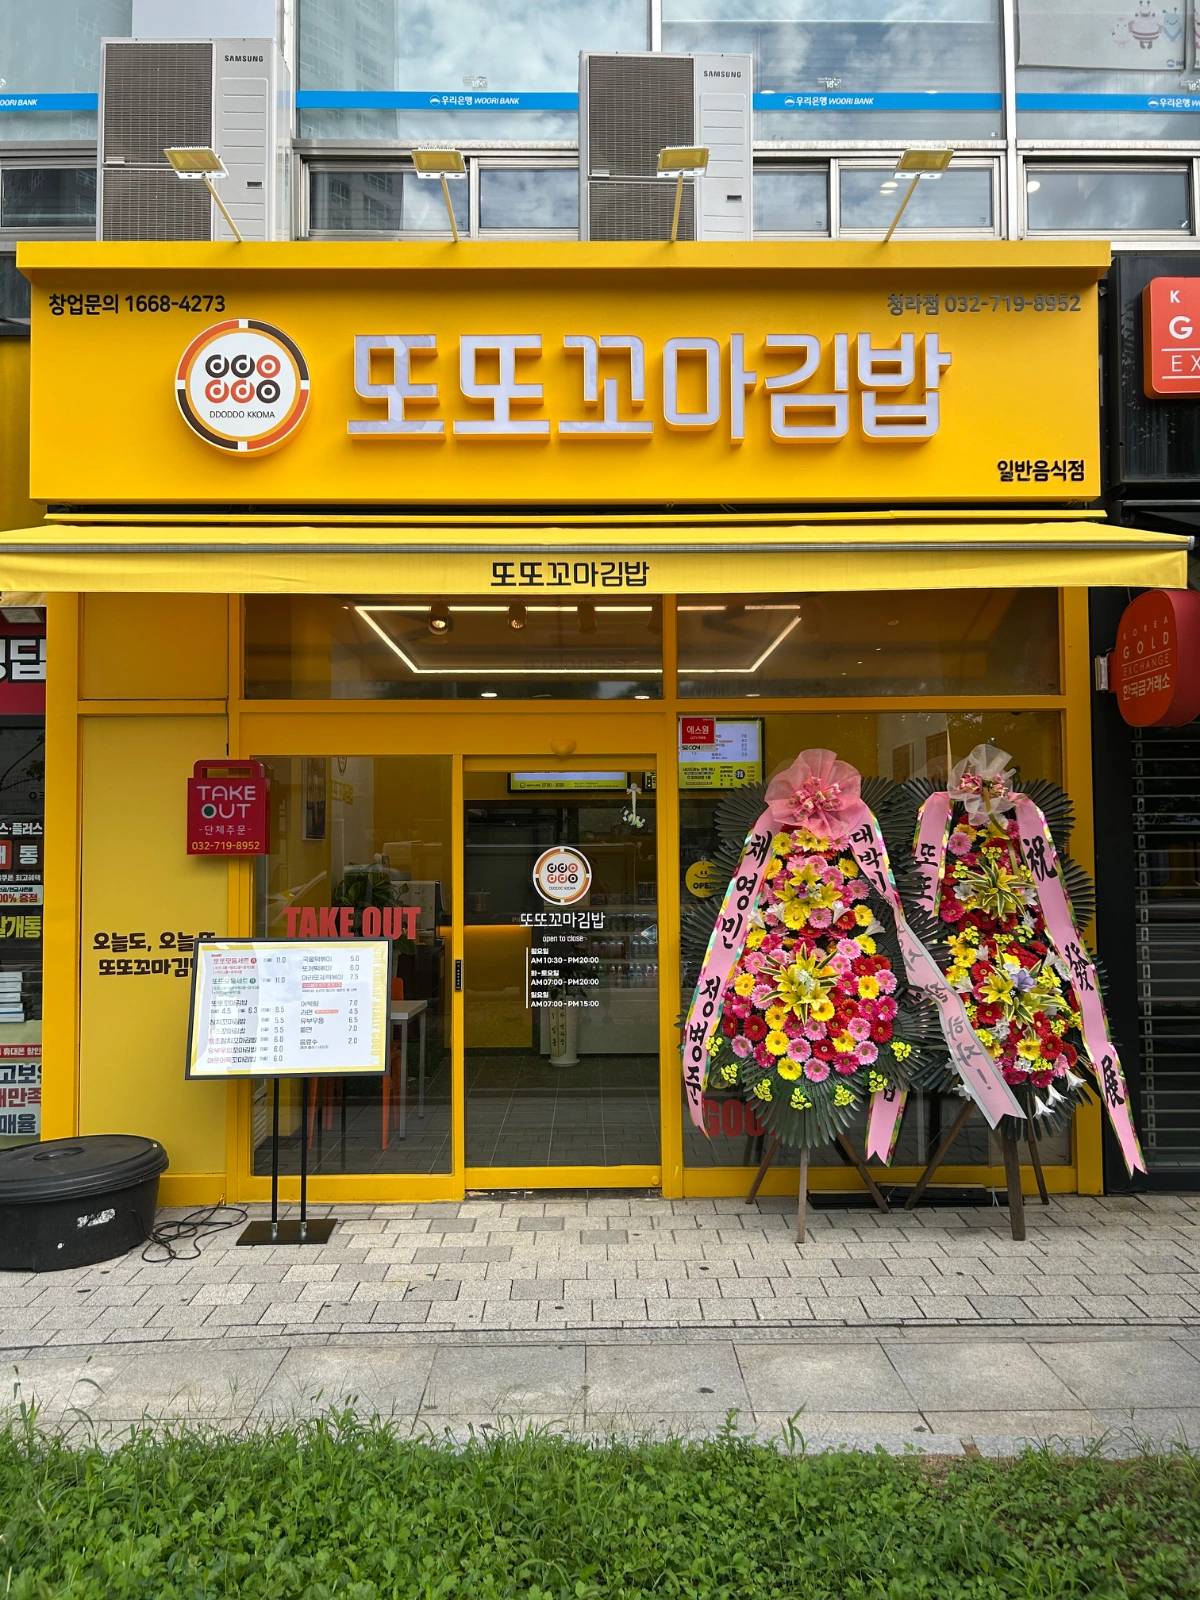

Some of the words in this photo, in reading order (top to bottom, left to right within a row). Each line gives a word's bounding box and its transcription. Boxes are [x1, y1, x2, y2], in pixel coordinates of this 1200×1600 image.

[224, 55, 264, 63] SAMSUNG
[703, 70, 742, 78] SAMSUNG
[0, 99, 17, 107] OORI
[17, 99, 38, 107] BANK
[441, 95, 473, 106] 우리은행
[474, 97, 499, 105] WOORI
[499, 97, 520, 105] BANK
[796, 96, 828, 107] 우리은행
[828, 97, 854, 105] WOORI
[854, 97, 875, 105] BANK
[1159, 97, 1191, 108] 우리은행
[48, 293, 120, 315] 창업문의
[124, 294, 226, 313] 1668-4273
[887, 293, 940, 316] 청라점
[944, 293, 1082, 313] 032-719-8952
[346, 332, 953, 443] 또또꼬마김밥
[209, 410, 245, 419] DDODDO
[246, 410, 276, 419] KKOMA
[997, 459, 1085, 482] 일반음식점
[490, 561, 650, 587] 또또꼬마김밥
[1123, 615, 1169, 640] KOREA
[1123, 631, 1169, 659] GOLD
[1123, 652, 1169, 677] EXCHANGE
[1122, 672, 1171, 701] 한국금거래소
[686, 725, 710, 735] 에스원
[196, 785, 257, 801] TAKE
[201, 803, 251, 819] OUT
[191, 841, 260, 850] 032-719-8952
[692, 882, 716, 890] OPE
[719, 830, 773, 950] 채영민
[283, 906, 355, 938] TAKE
[362, 906, 422, 940] OUT
[519, 911, 606, 929] 또또꼬마김밥
[92, 931, 152, 952] 오늘도,
[542, 935, 557, 943] open
[530, 947, 549, 955] 월요일
[98, 957, 194, 978] 또또꼬마김
[530, 991, 549, 999] 일요일
[348, 1007, 359, 1015] 4.5
[300, 1017, 325, 1025] 유부우동
[348, 1016, 359, 1024] 6.5
[274, 1026, 284, 1034] 5.5
[273, 1035, 284, 1043] 6.0
[299, 1038, 318, 1046] 음료수
[347, 1037, 358, 1045] 2.0
[273, 1045, 284, 1053] 6.0
[703, 1098, 777, 1138] GOO
